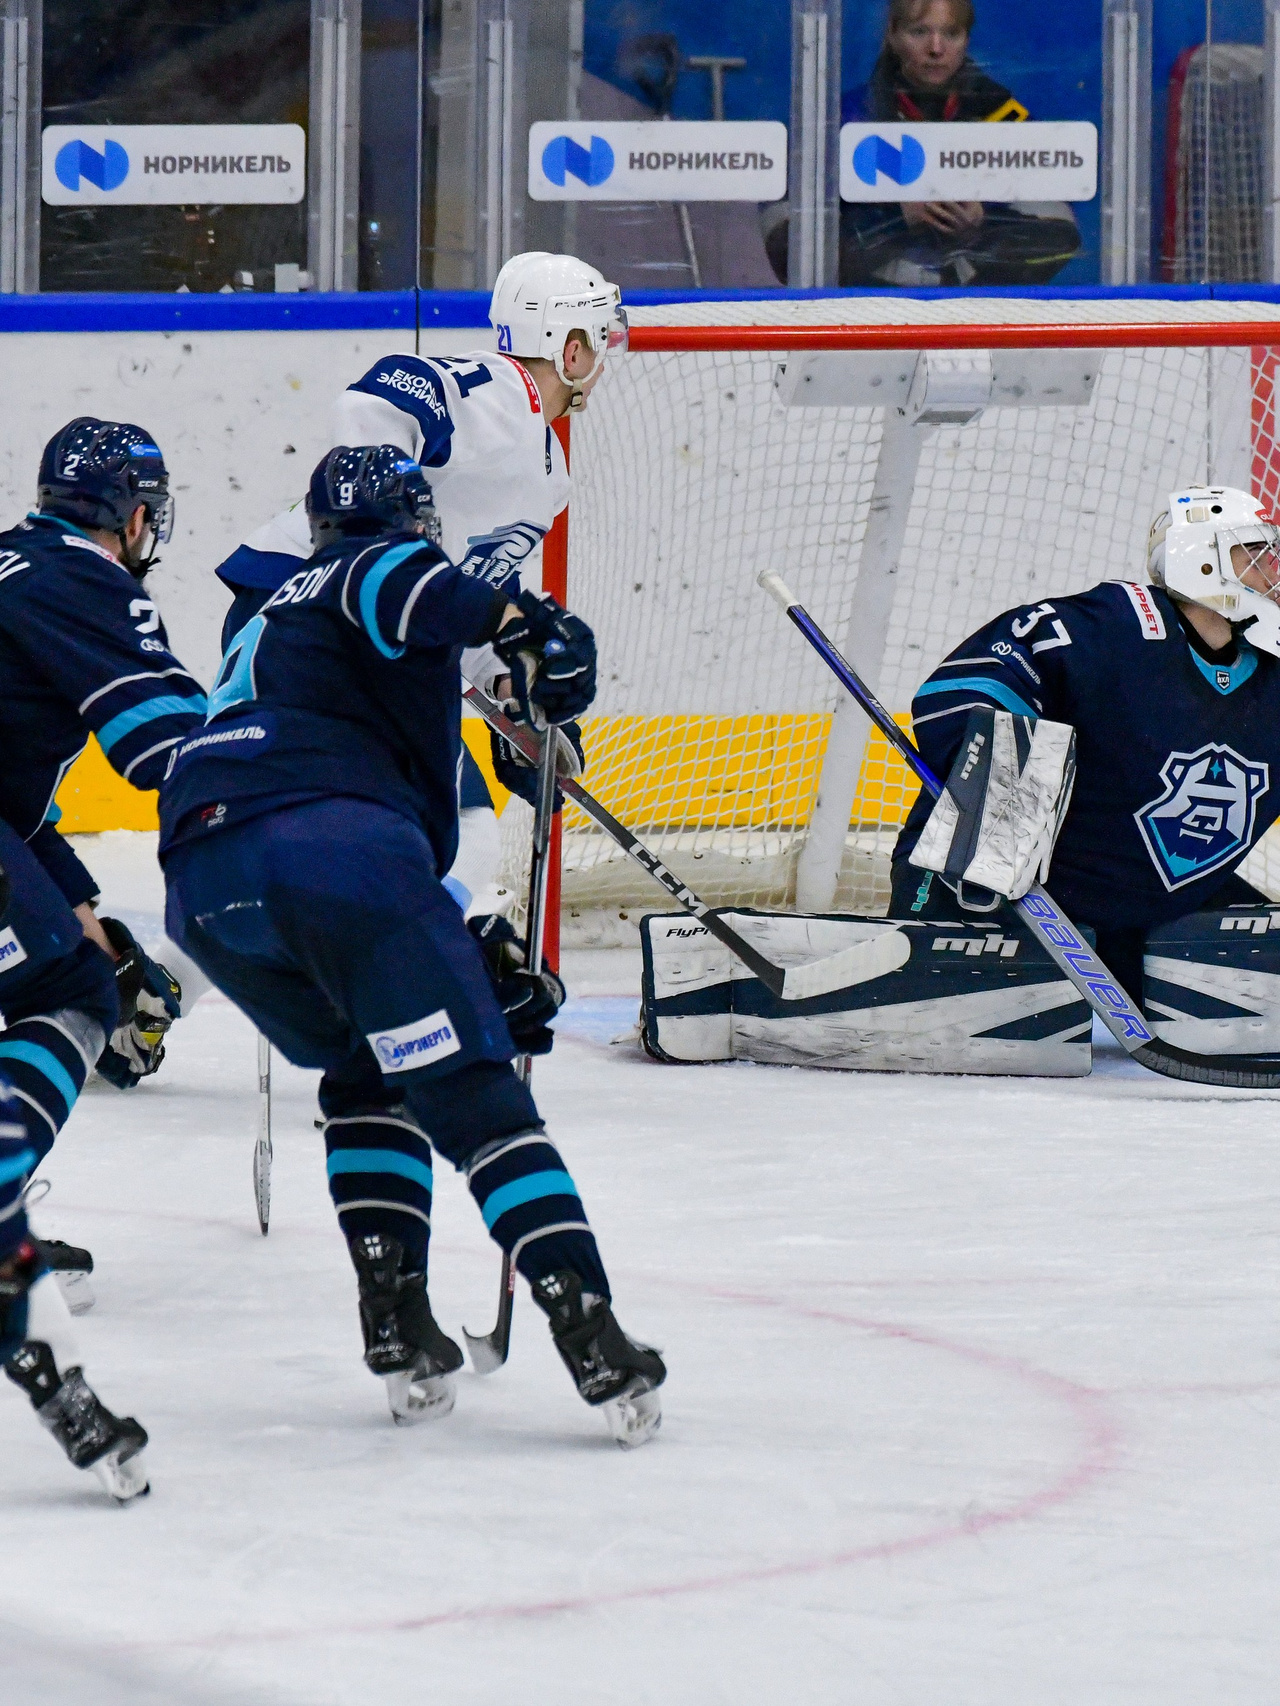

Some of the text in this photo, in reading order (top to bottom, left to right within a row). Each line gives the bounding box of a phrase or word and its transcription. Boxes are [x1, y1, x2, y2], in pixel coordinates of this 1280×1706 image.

[143, 154, 291, 175] НОРНИКЕЛЬ
[628, 150, 773, 172] НОРНИКЕЛЬ
[939, 149, 1083, 169] НОРНИКЕЛЬ
[497, 324, 512, 352] 21
[63, 454, 80, 477] 2
[339, 482, 354, 506] 9
[1011, 602, 1073, 655] 37
[629, 842, 711, 918] CCM
